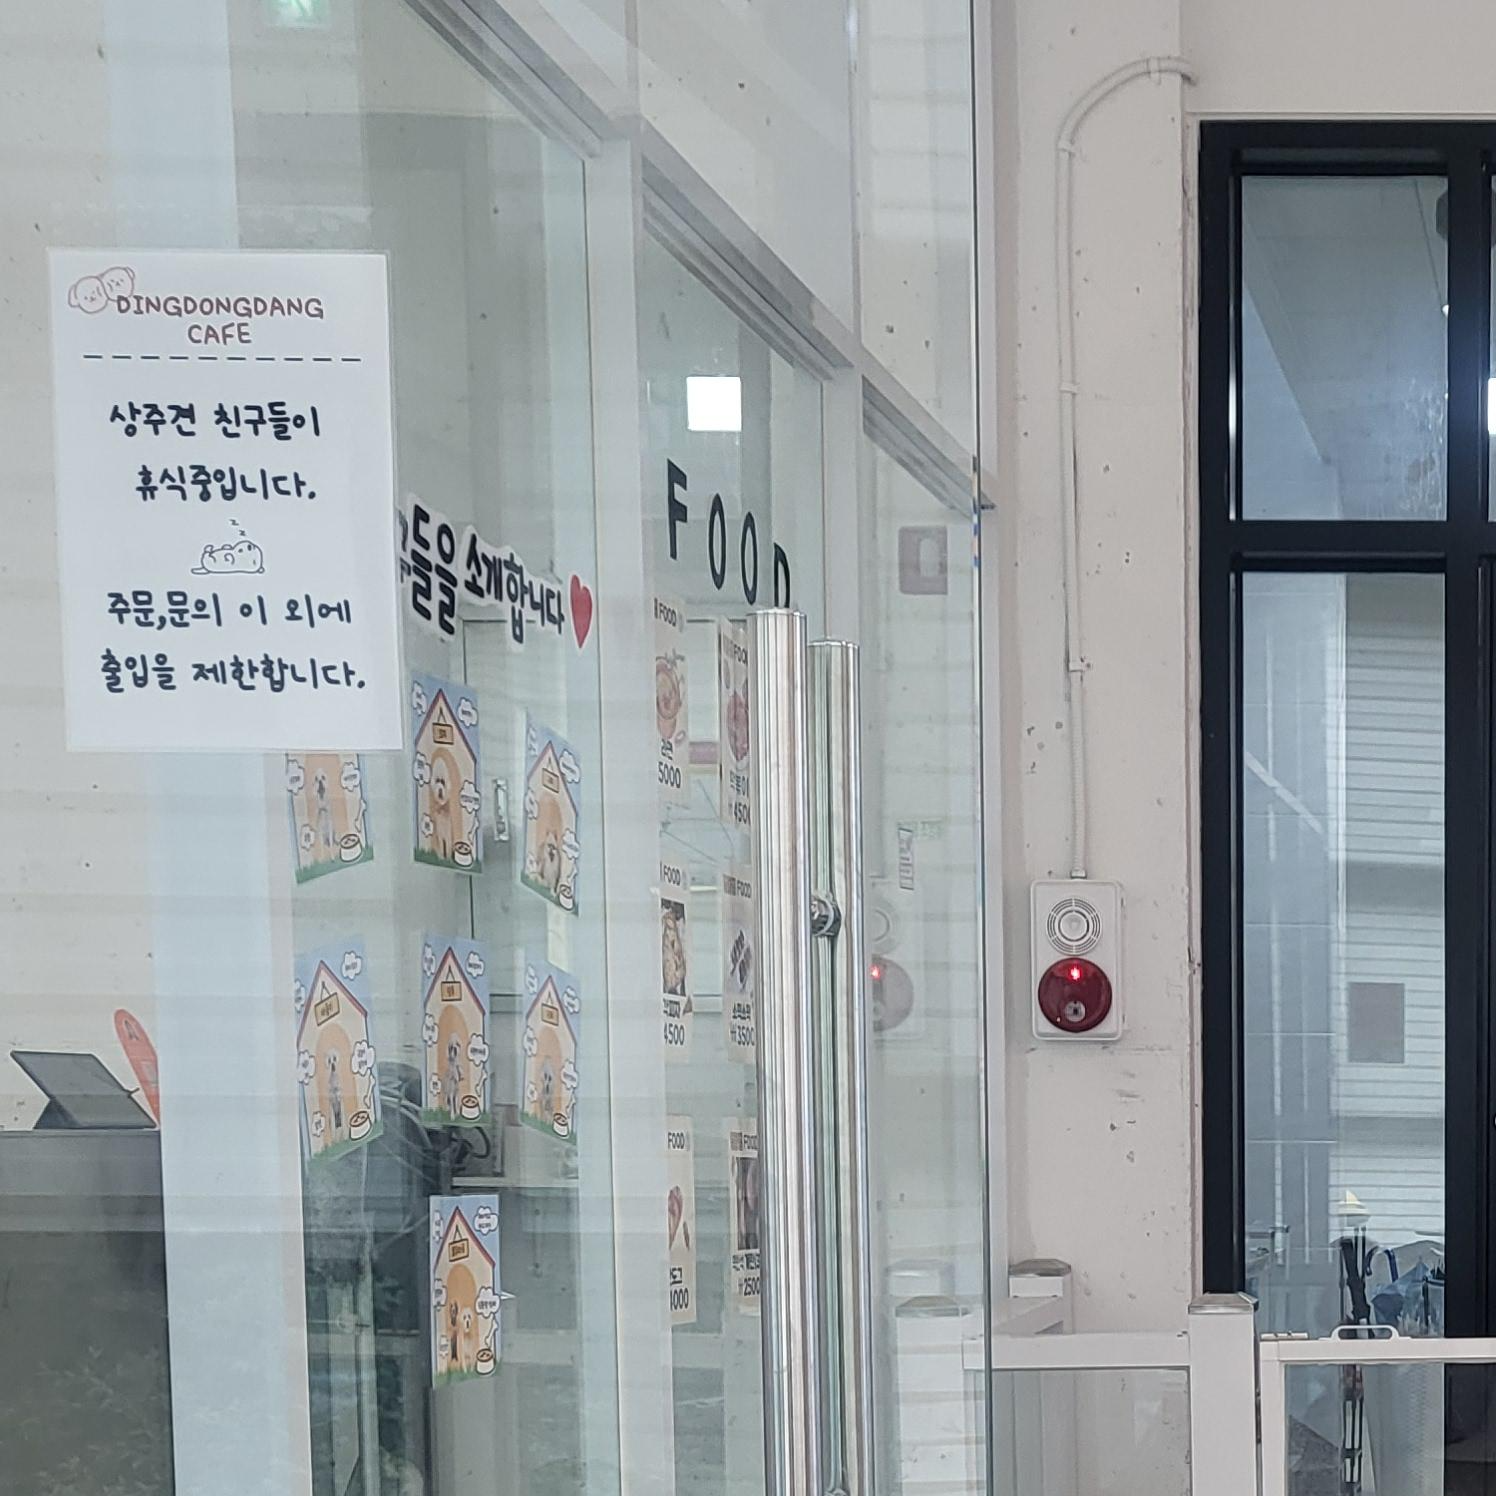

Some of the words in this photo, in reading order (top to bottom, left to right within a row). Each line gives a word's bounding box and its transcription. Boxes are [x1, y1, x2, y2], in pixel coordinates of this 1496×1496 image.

[116, 295, 324, 319] DINGDONGDANG
[187, 322, 253, 345] CAFE
[109, 401, 197, 438] 상주견
[213, 401, 321, 441] 친구들이
[135, 464, 316, 502] 휴식중입니다.
[464, 533, 566, 645] 소개합니다
[106, 590, 222, 630] 주문,문의
[239, 594, 268, 626] 이
[284, 595, 352, 629] 외에
[100, 648, 176, 693] 출입을
[192, 653, 367, 692] 제한합니다.
